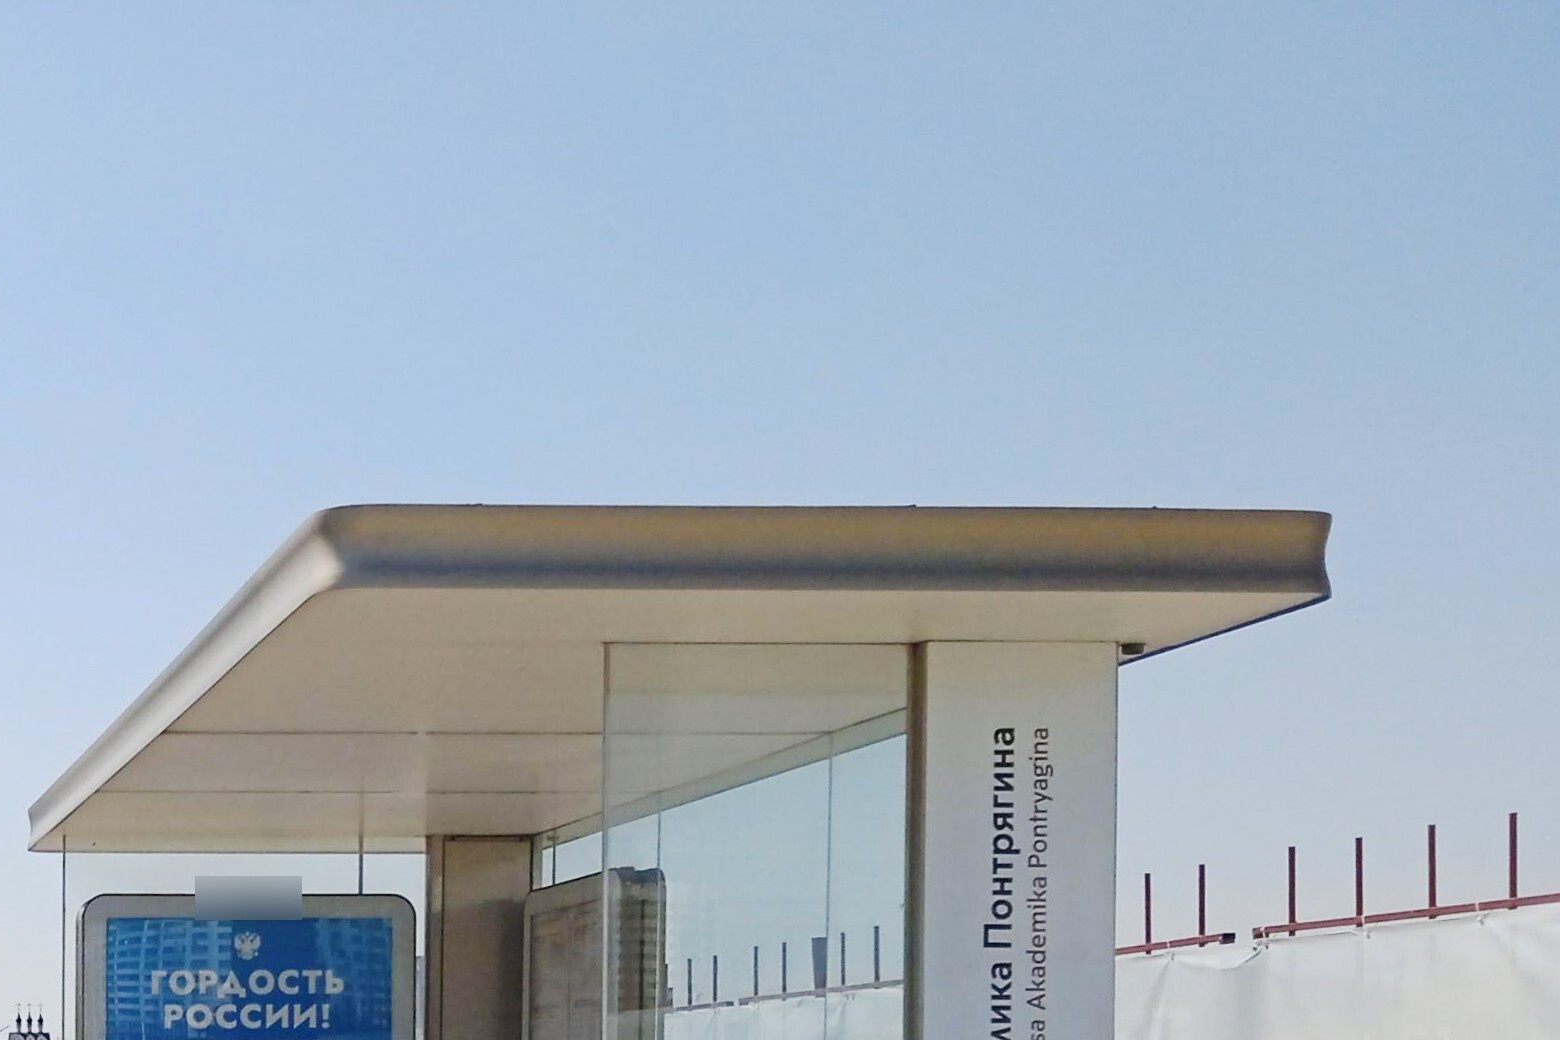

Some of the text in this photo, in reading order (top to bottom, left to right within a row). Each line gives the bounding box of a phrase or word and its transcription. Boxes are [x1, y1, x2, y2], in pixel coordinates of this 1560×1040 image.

[983, 726, 1021, 949] Понтрягина
[1027, 726, 1054, 869] Pontryagina
[150, 968, 346, 999] ГОРДОСТЬ
[1025, 877, 1048, 1011] Akademika
[163, 1003, 332, 1030] РОССИИ!
